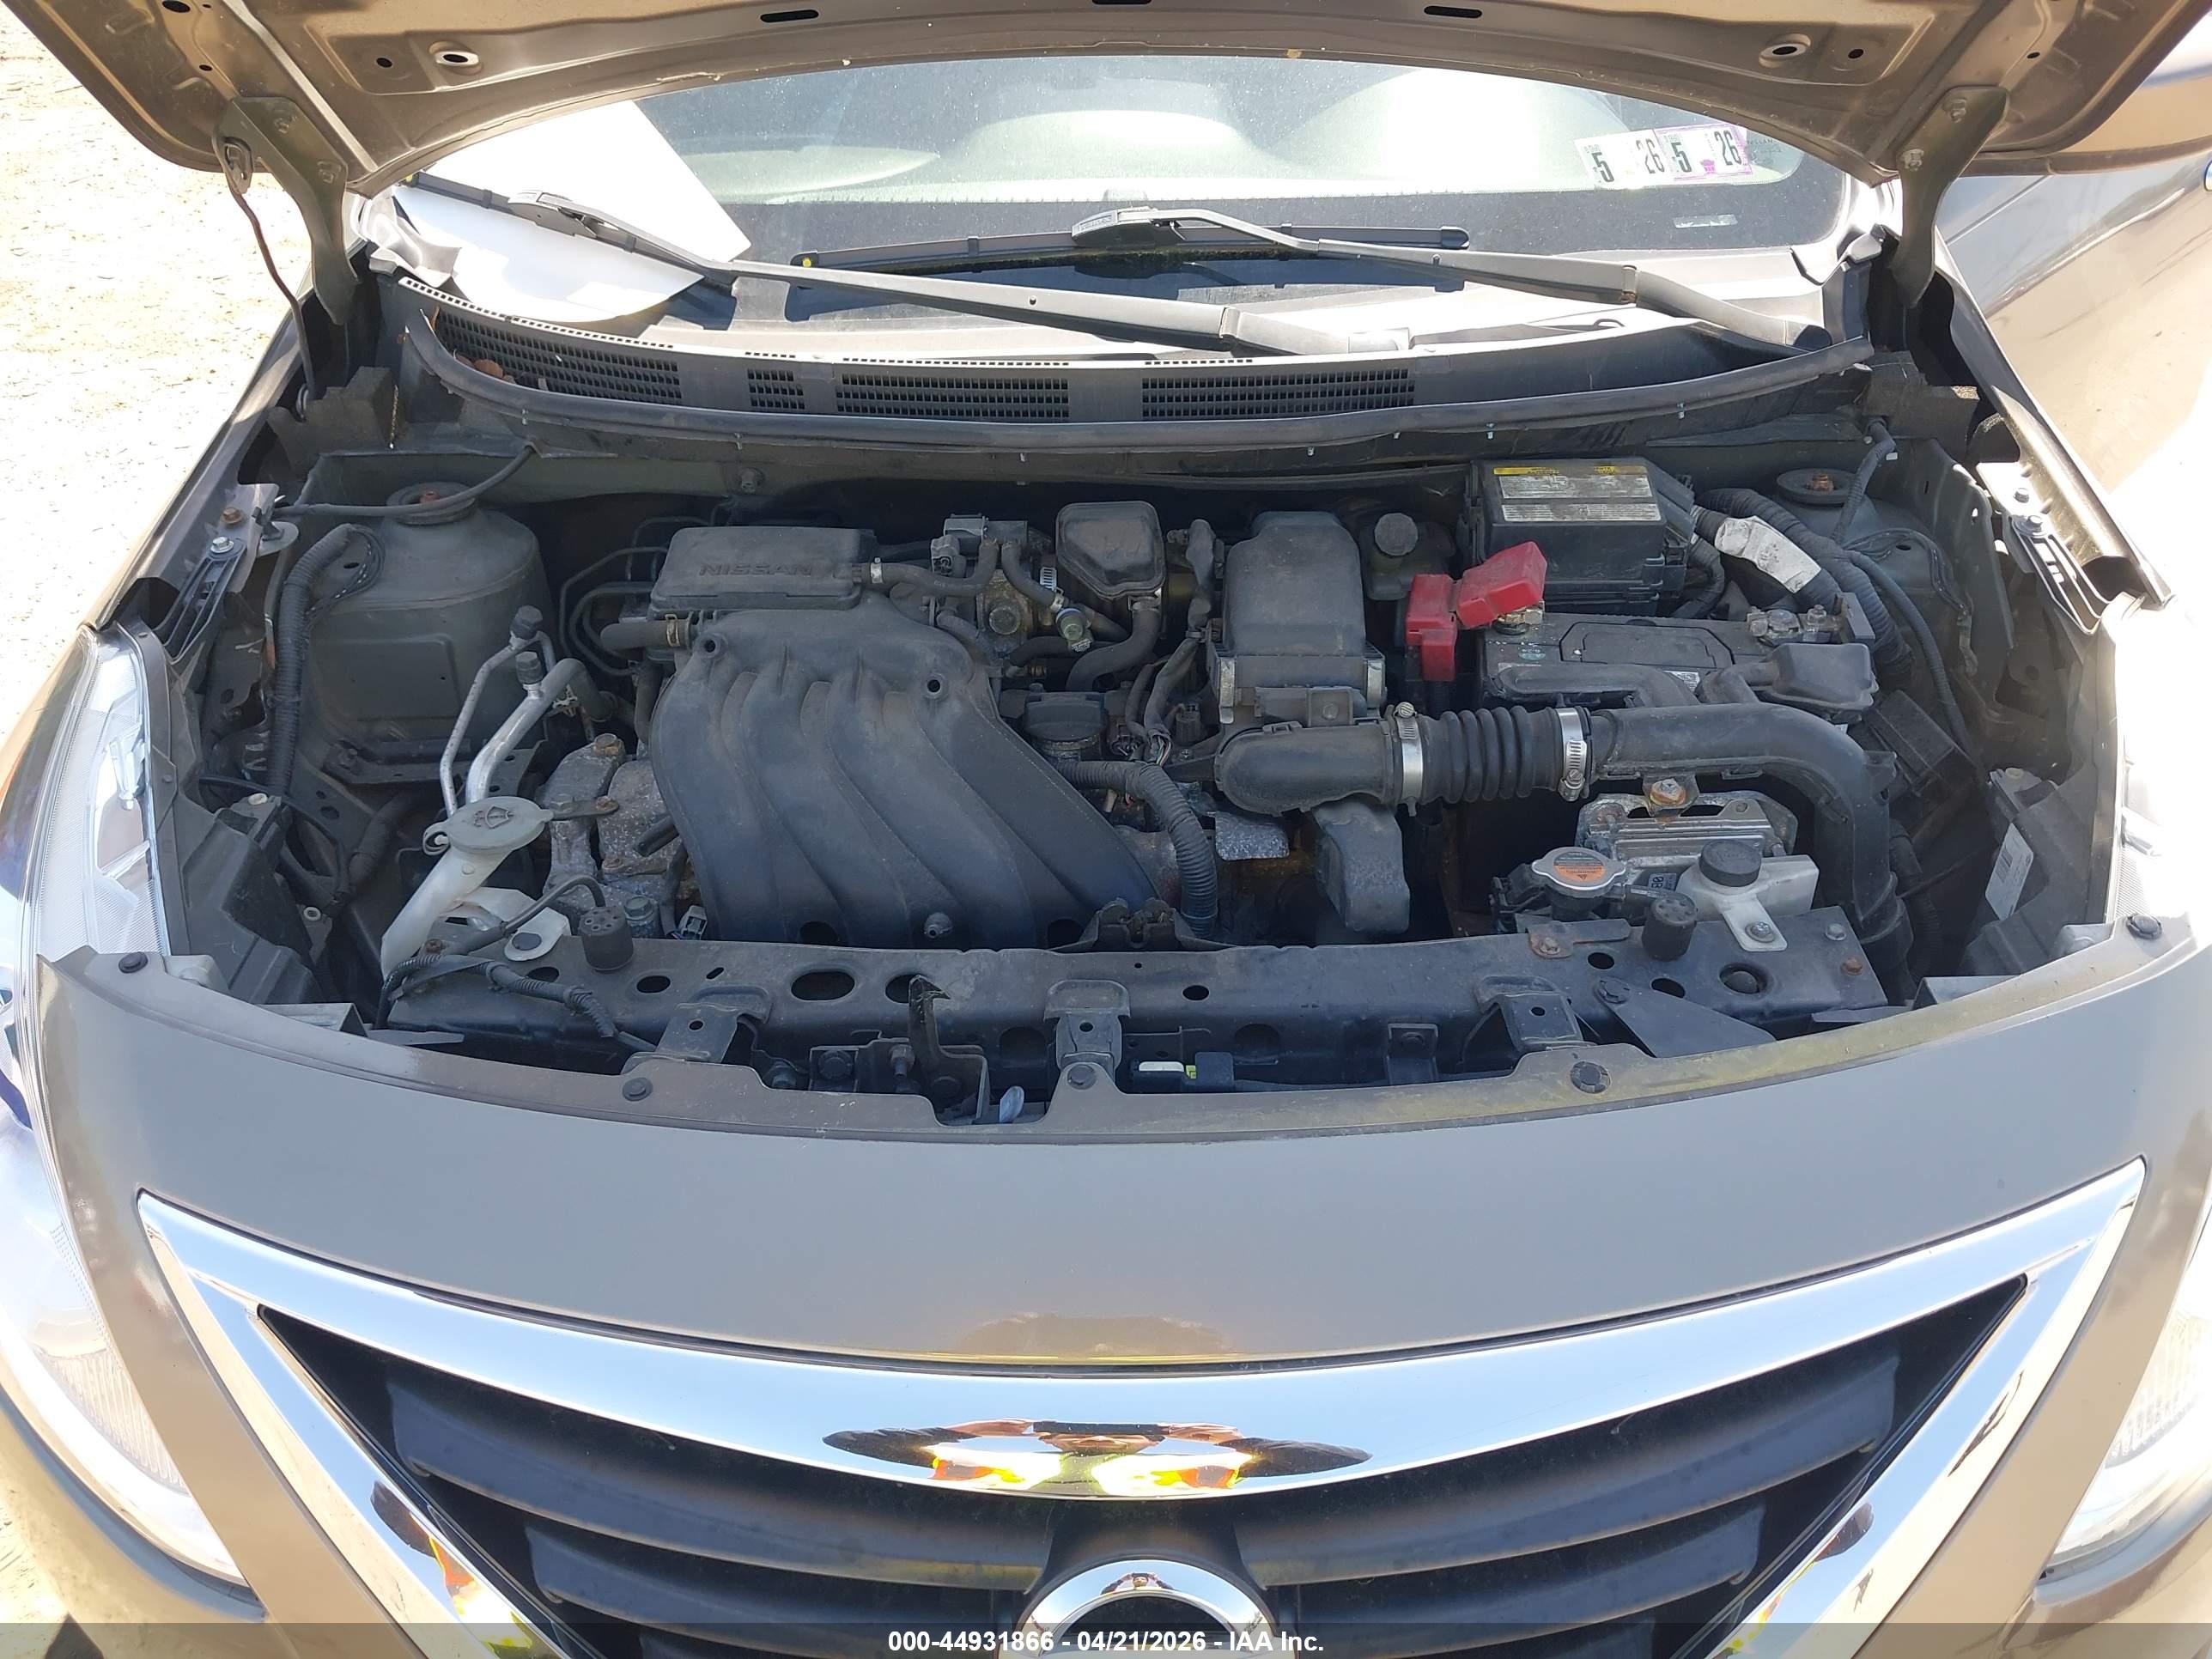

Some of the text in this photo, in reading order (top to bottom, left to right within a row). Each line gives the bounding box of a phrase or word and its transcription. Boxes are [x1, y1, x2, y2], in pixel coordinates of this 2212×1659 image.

[1591, 138, 1665, 183] 5 26
[1670, 142, 1692, 173] 5
[1714, 130, 1742, 166] 26
[699, 563, 812, 576] NISSAN
